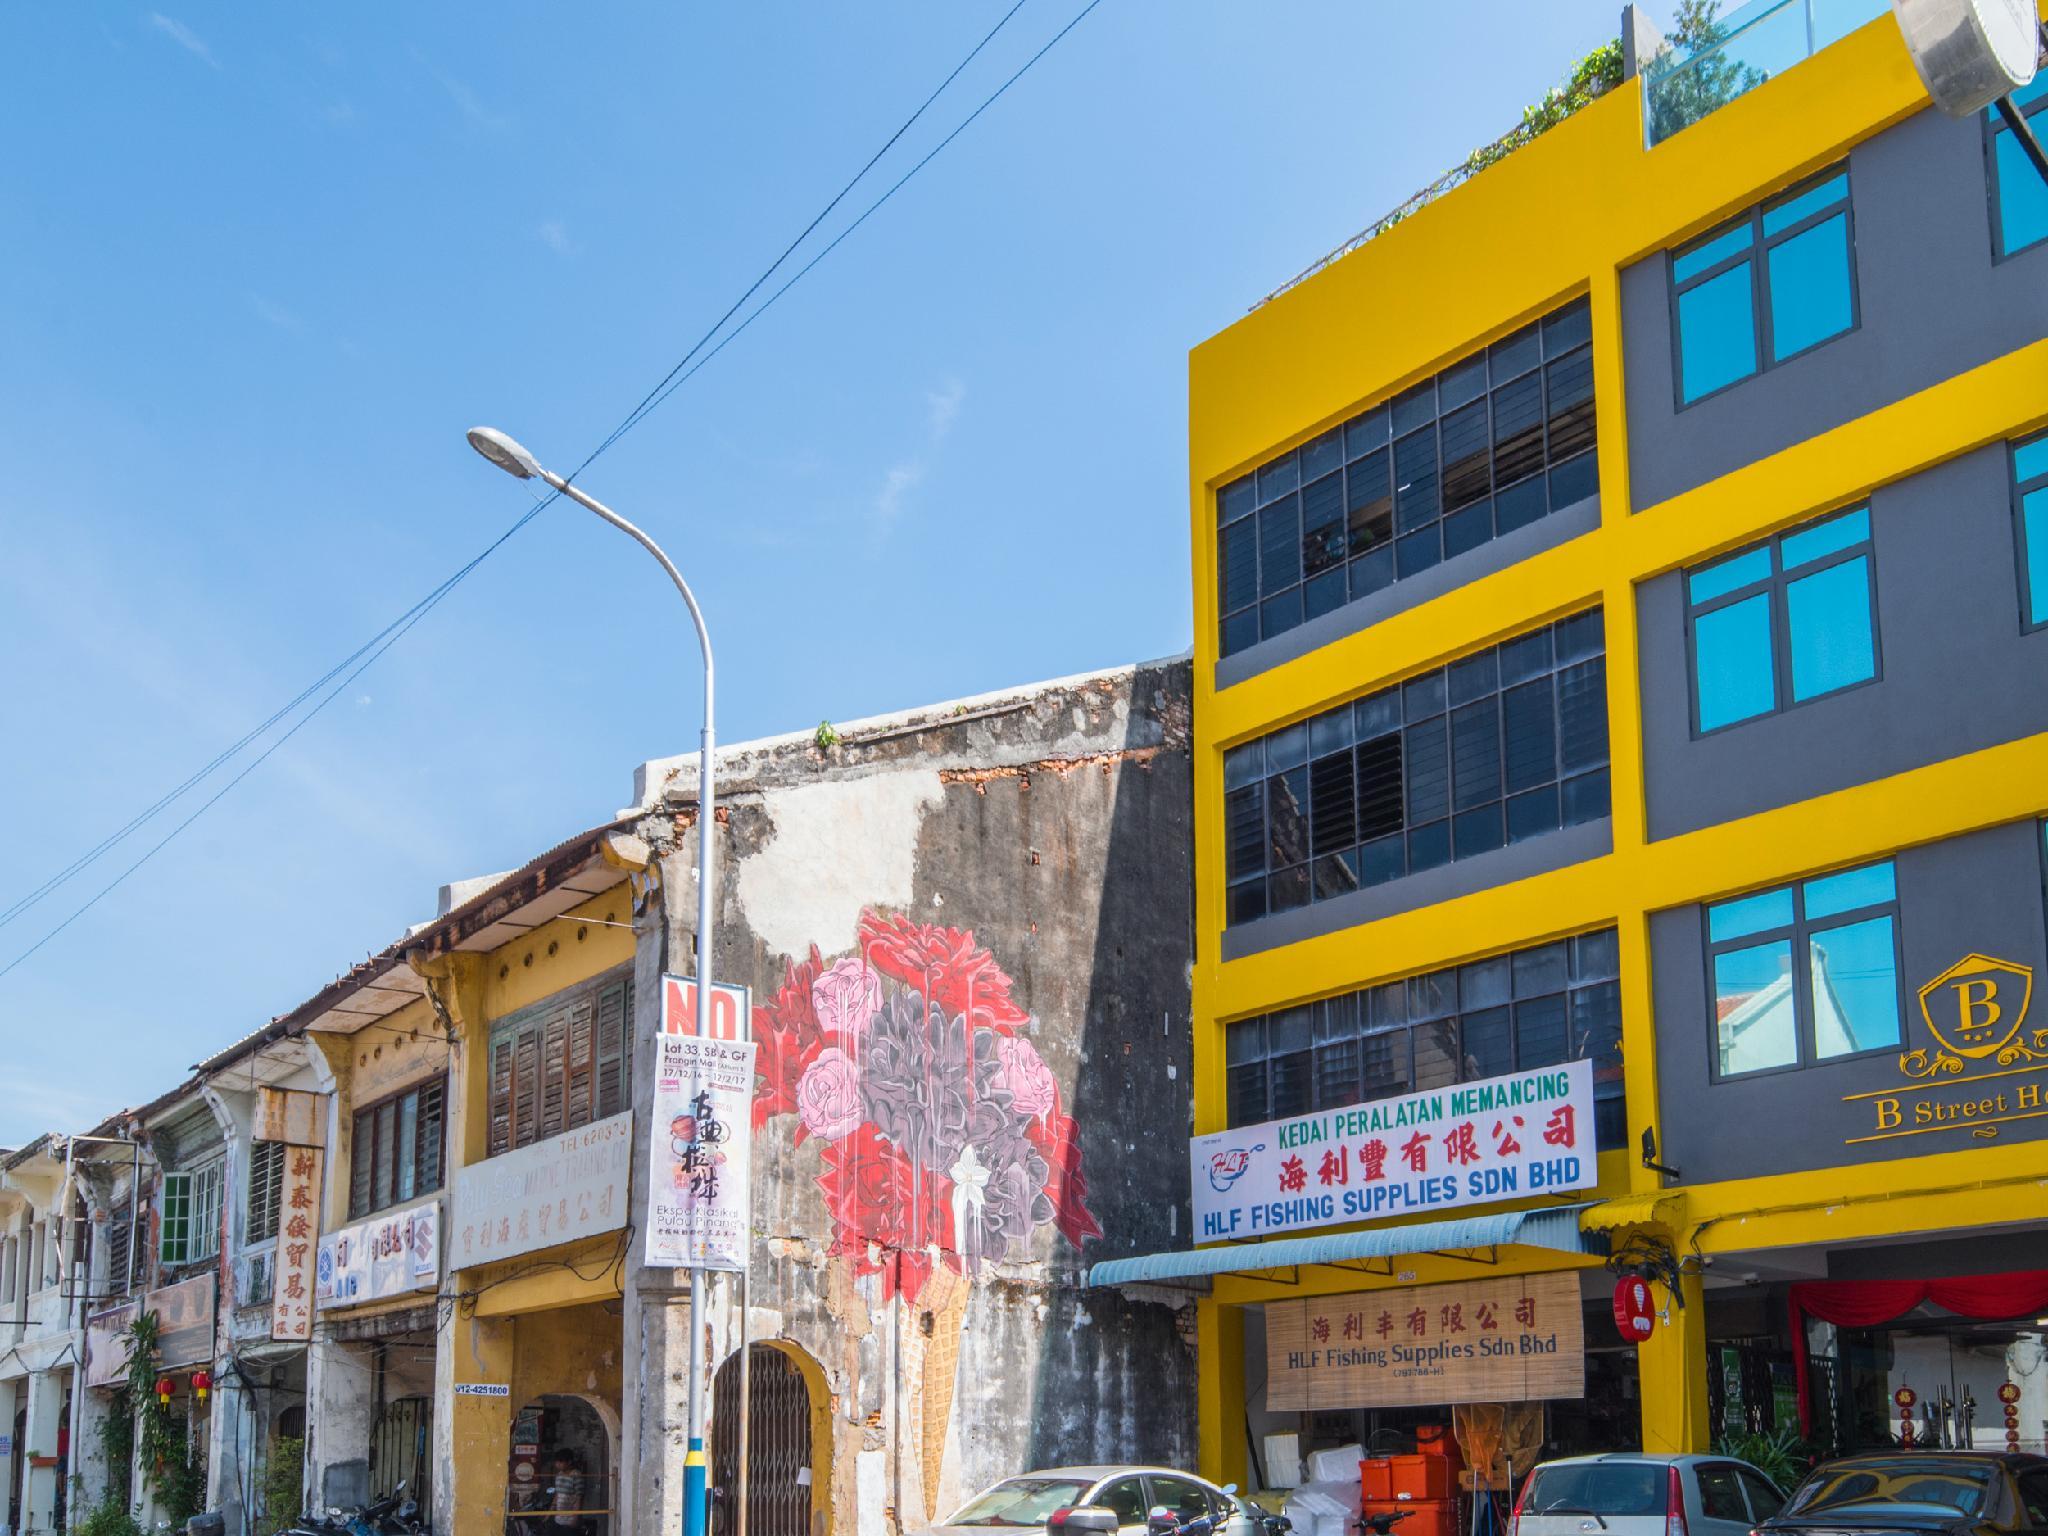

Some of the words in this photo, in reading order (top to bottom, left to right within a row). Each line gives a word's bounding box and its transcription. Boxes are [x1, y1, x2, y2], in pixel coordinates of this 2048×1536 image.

[1951, 979, 2001, 1032] B
[664, 1043, 682, 1054] Lot
[720, 1050, 728, 1059] &
[664, 1056, 697, 1066] Prangin
[663, 1069, 702, 1079] 17/12/16
[713, 1073, 746, 1084] 12/2/17
[1279, 1115, 1328, 1149] KEDAI
[1335, 1095, 1443, 1138] PERALATAN
[1451, 1071, 1570, 1117] MEMANCING
[1874, 1098, 1902, 1130] B
[1915, 1094, 2008, 1124] Street
[2016, 1084, 2048, 1109] H
[1278, 1104, 1576, 1194] 海利豐有限公司
[1204, 1208, 1242, 1236] HLF
[1251, 1195, 1334, 1229] FISHING
[1343, 1175, 1458, 1215] SUPPLIES
[1468, 1166, 1517, 1197] SDN
[1529, 1156, 1580, 1189] BHD
[657, 1216, 692, 1227] Pulau
[1312, 1297, 1536, 1344] 海利丰有限公司
[1288, 1350, 1320, 1369] HLF
[1326, 1348, 1386, 1368] Fishing
[1391, 1339, 1474, 1367] Supplies
[1479, 1337, 1514, 1357] Sdn
[1519, 1333, 1557, 1354] Bhd
